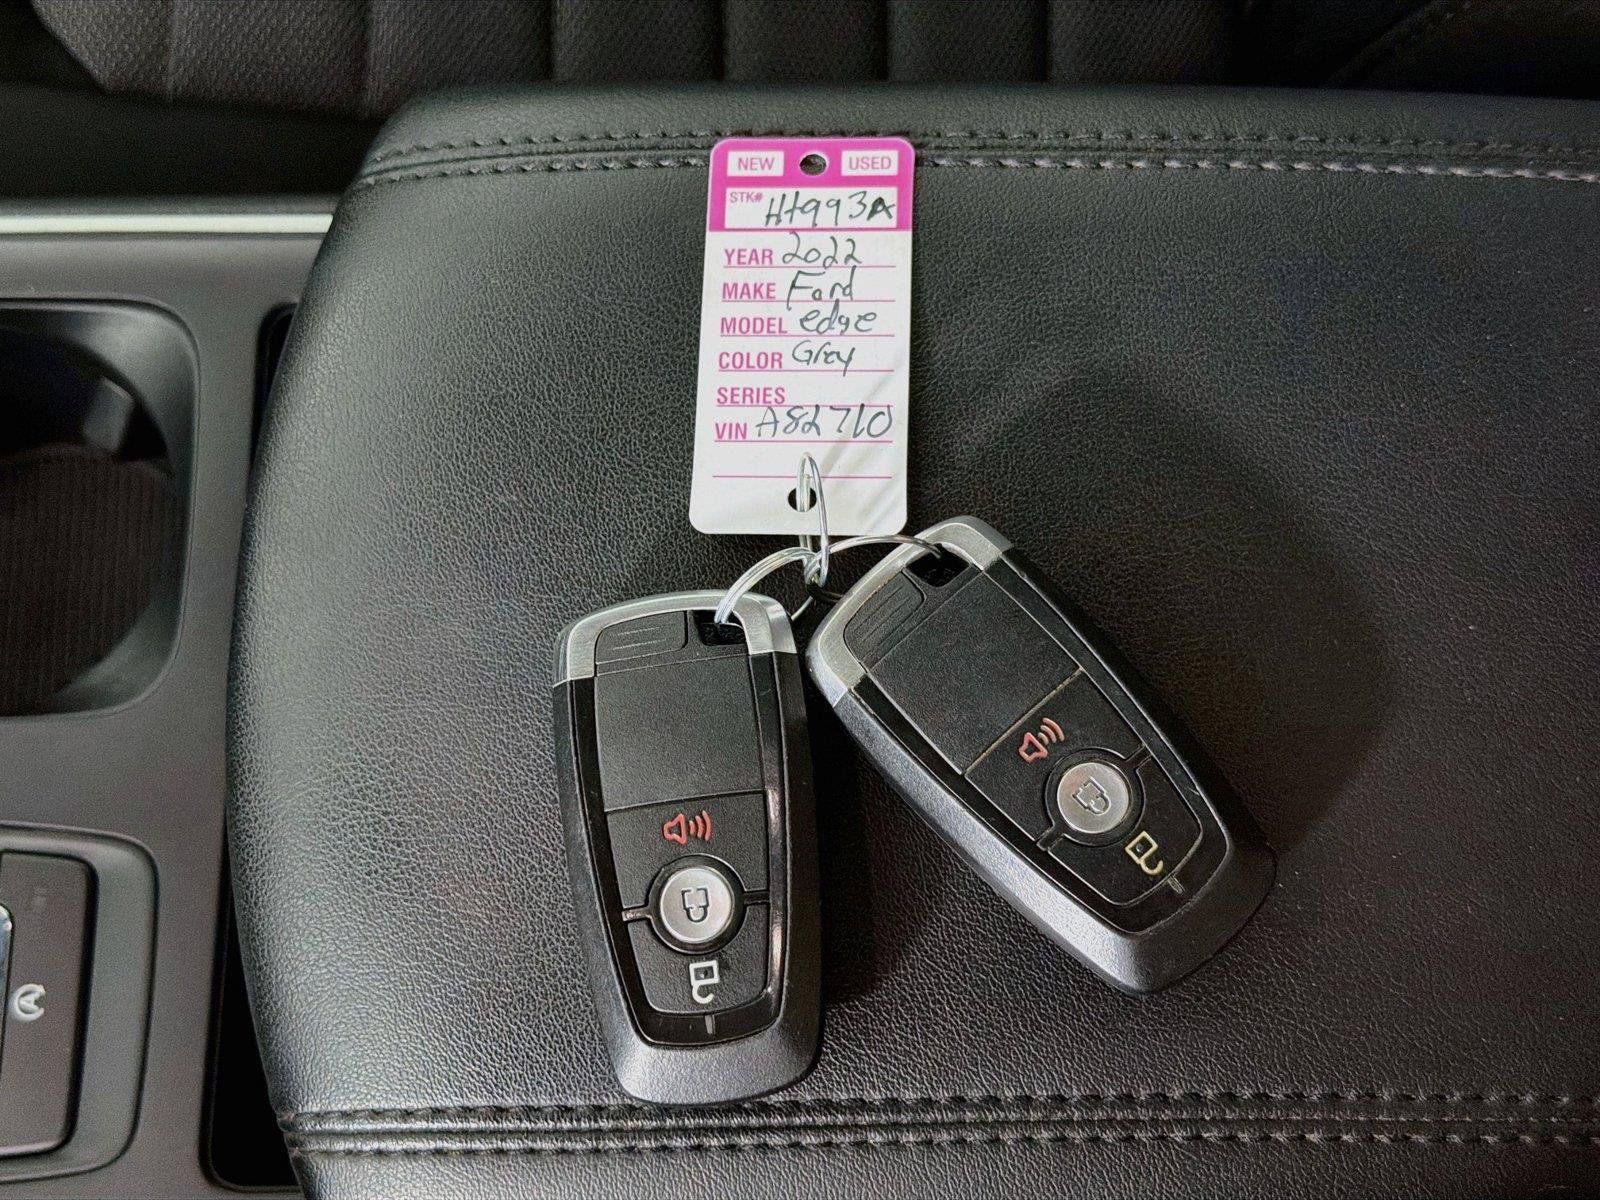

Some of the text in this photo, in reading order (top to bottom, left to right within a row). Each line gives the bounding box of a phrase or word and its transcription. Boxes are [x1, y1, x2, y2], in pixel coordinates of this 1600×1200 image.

[738, 157, 775, 170] NEW
[848, 156, 892, 170] USED
[729, 191, 763, 203] STK#
[724, 231, 862, 270] YEAR 2022
[722, 265, 857, 310] MAKE Ford
[720, 316, 788, 334] MODEL
[718, 351, 783, 369] COLOR
[716, 386, 786, 404] SERIES
[715, 422, 748, 439] VIN
